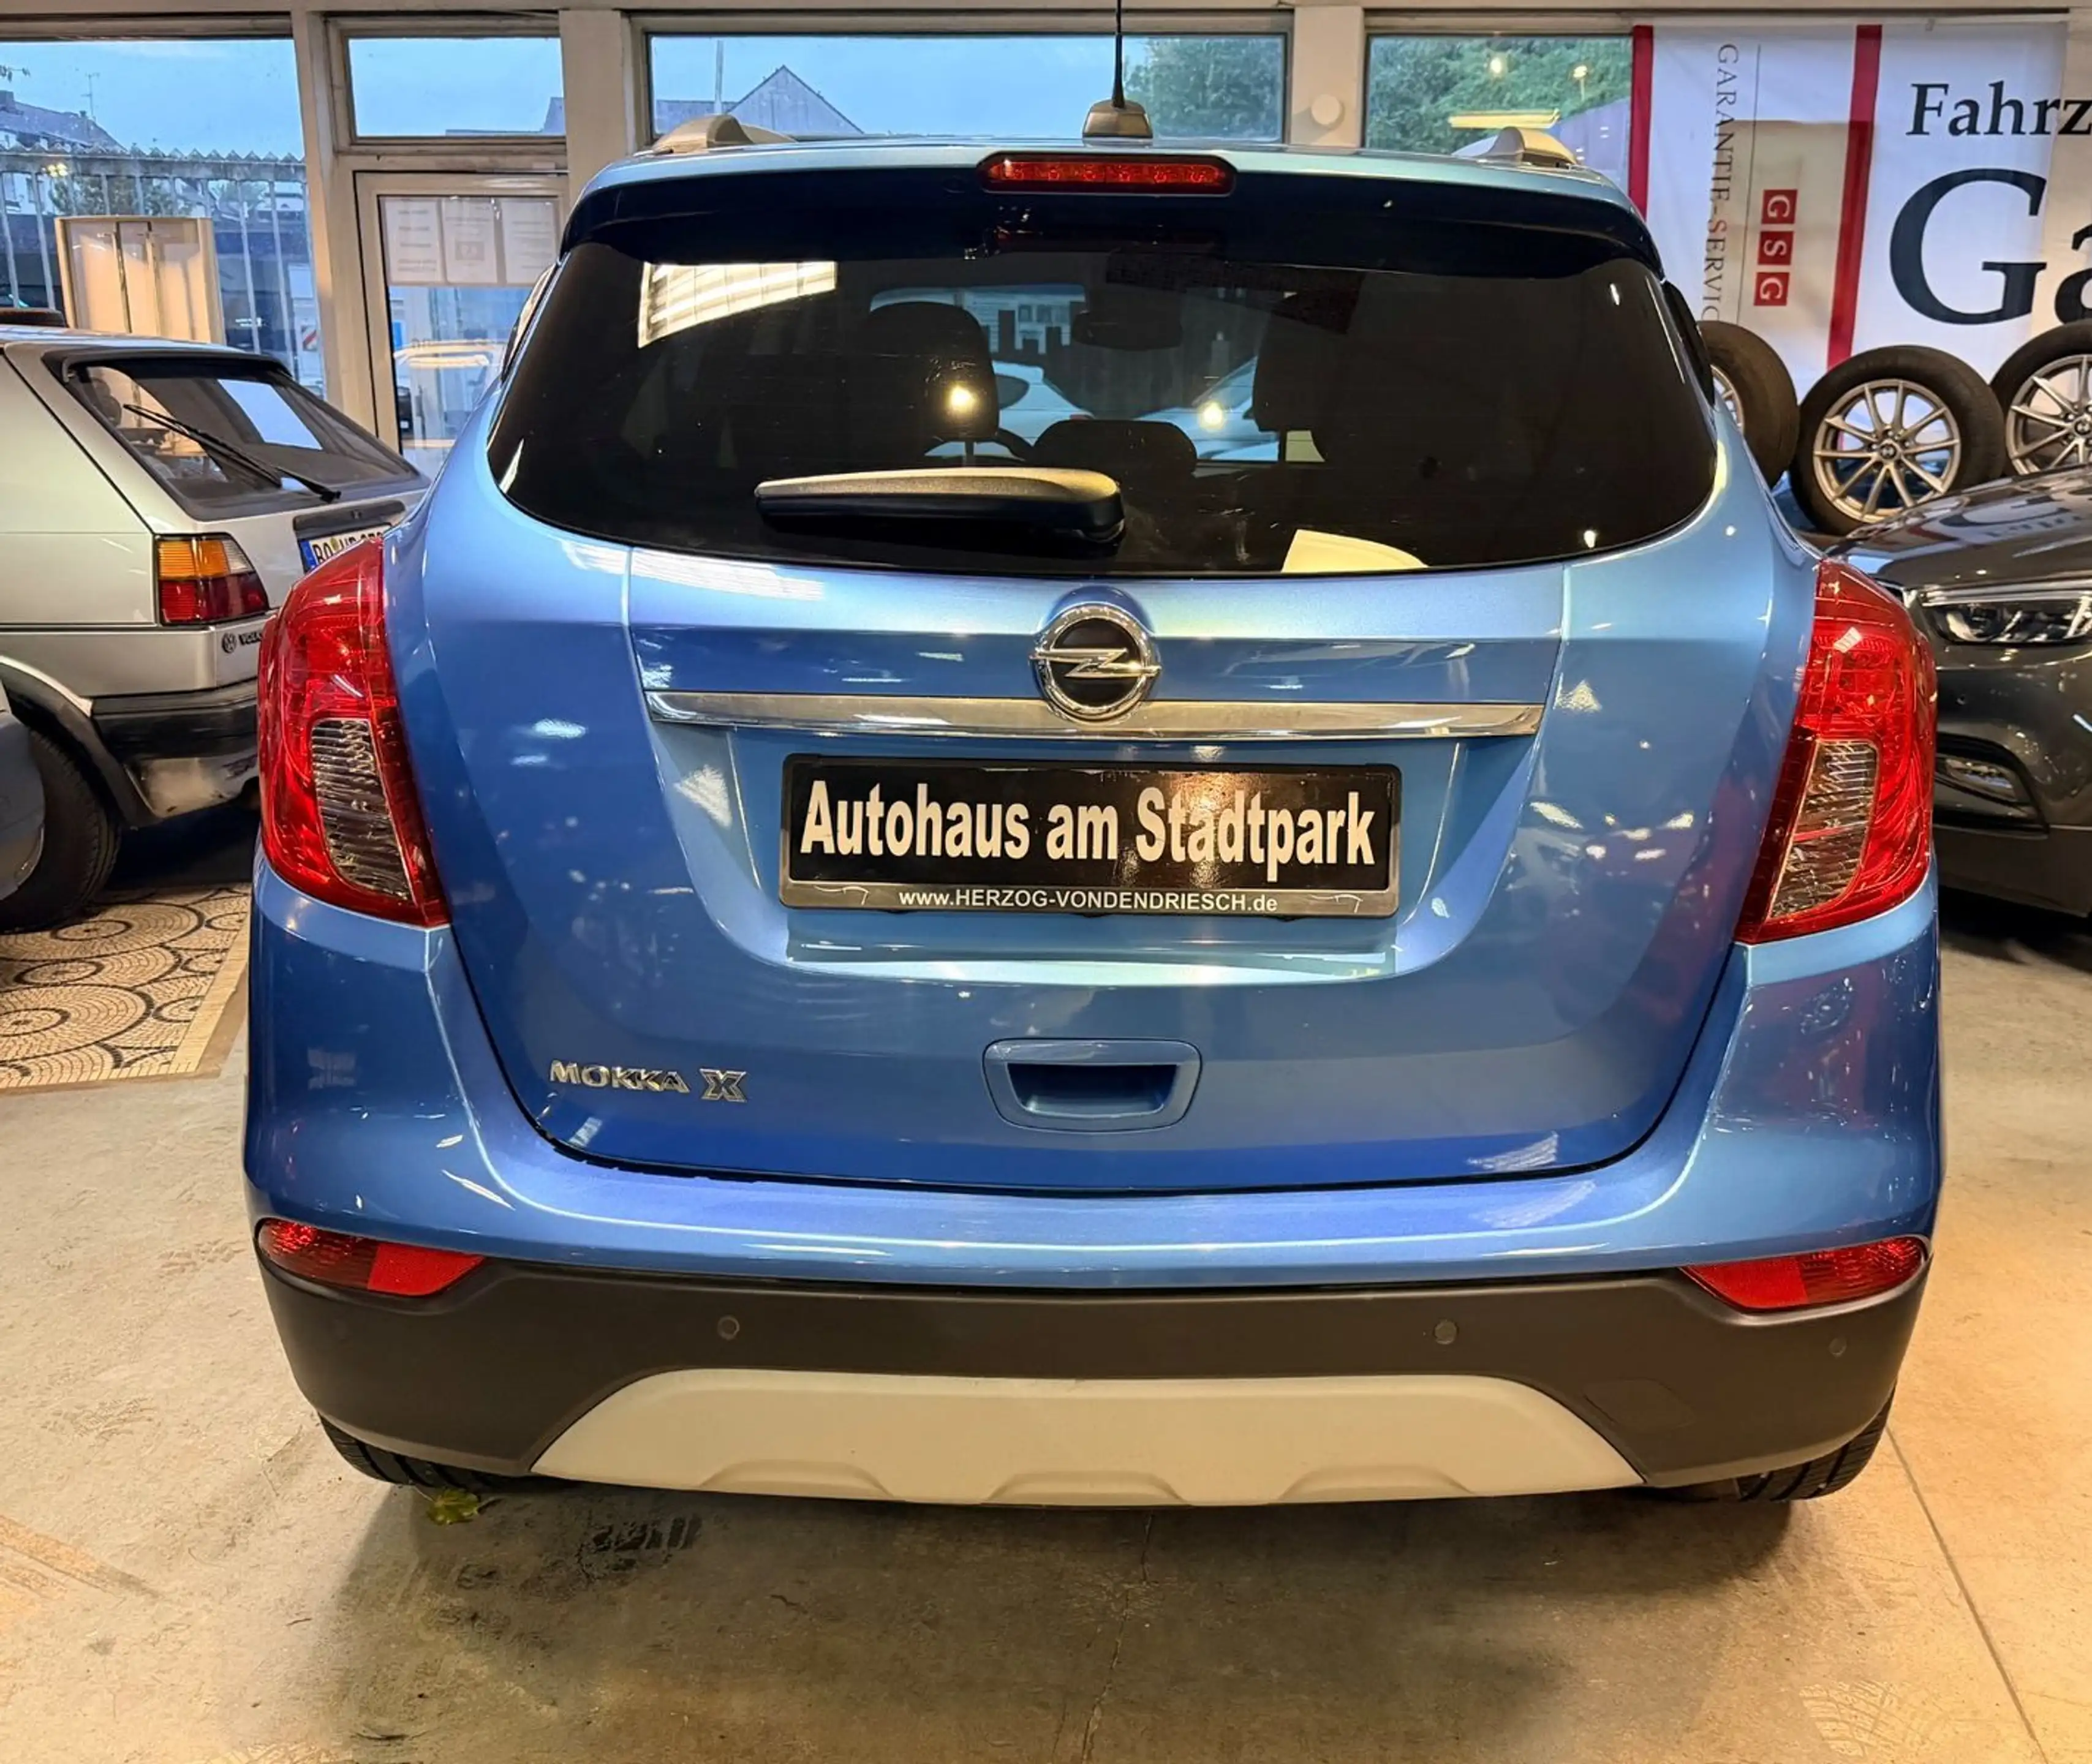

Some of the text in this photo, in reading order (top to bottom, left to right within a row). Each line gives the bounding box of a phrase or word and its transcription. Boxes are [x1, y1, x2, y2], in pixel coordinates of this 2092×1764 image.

[1759, 194, 1792, 301] GSG
[800, 780, 1376, 883] Autohaus am Stadtpark
[899, 888, 1278, 913] www.HERZOG-VONDENDRIESCH.de
[549, 1060, 748, 1103] MOKKA X
